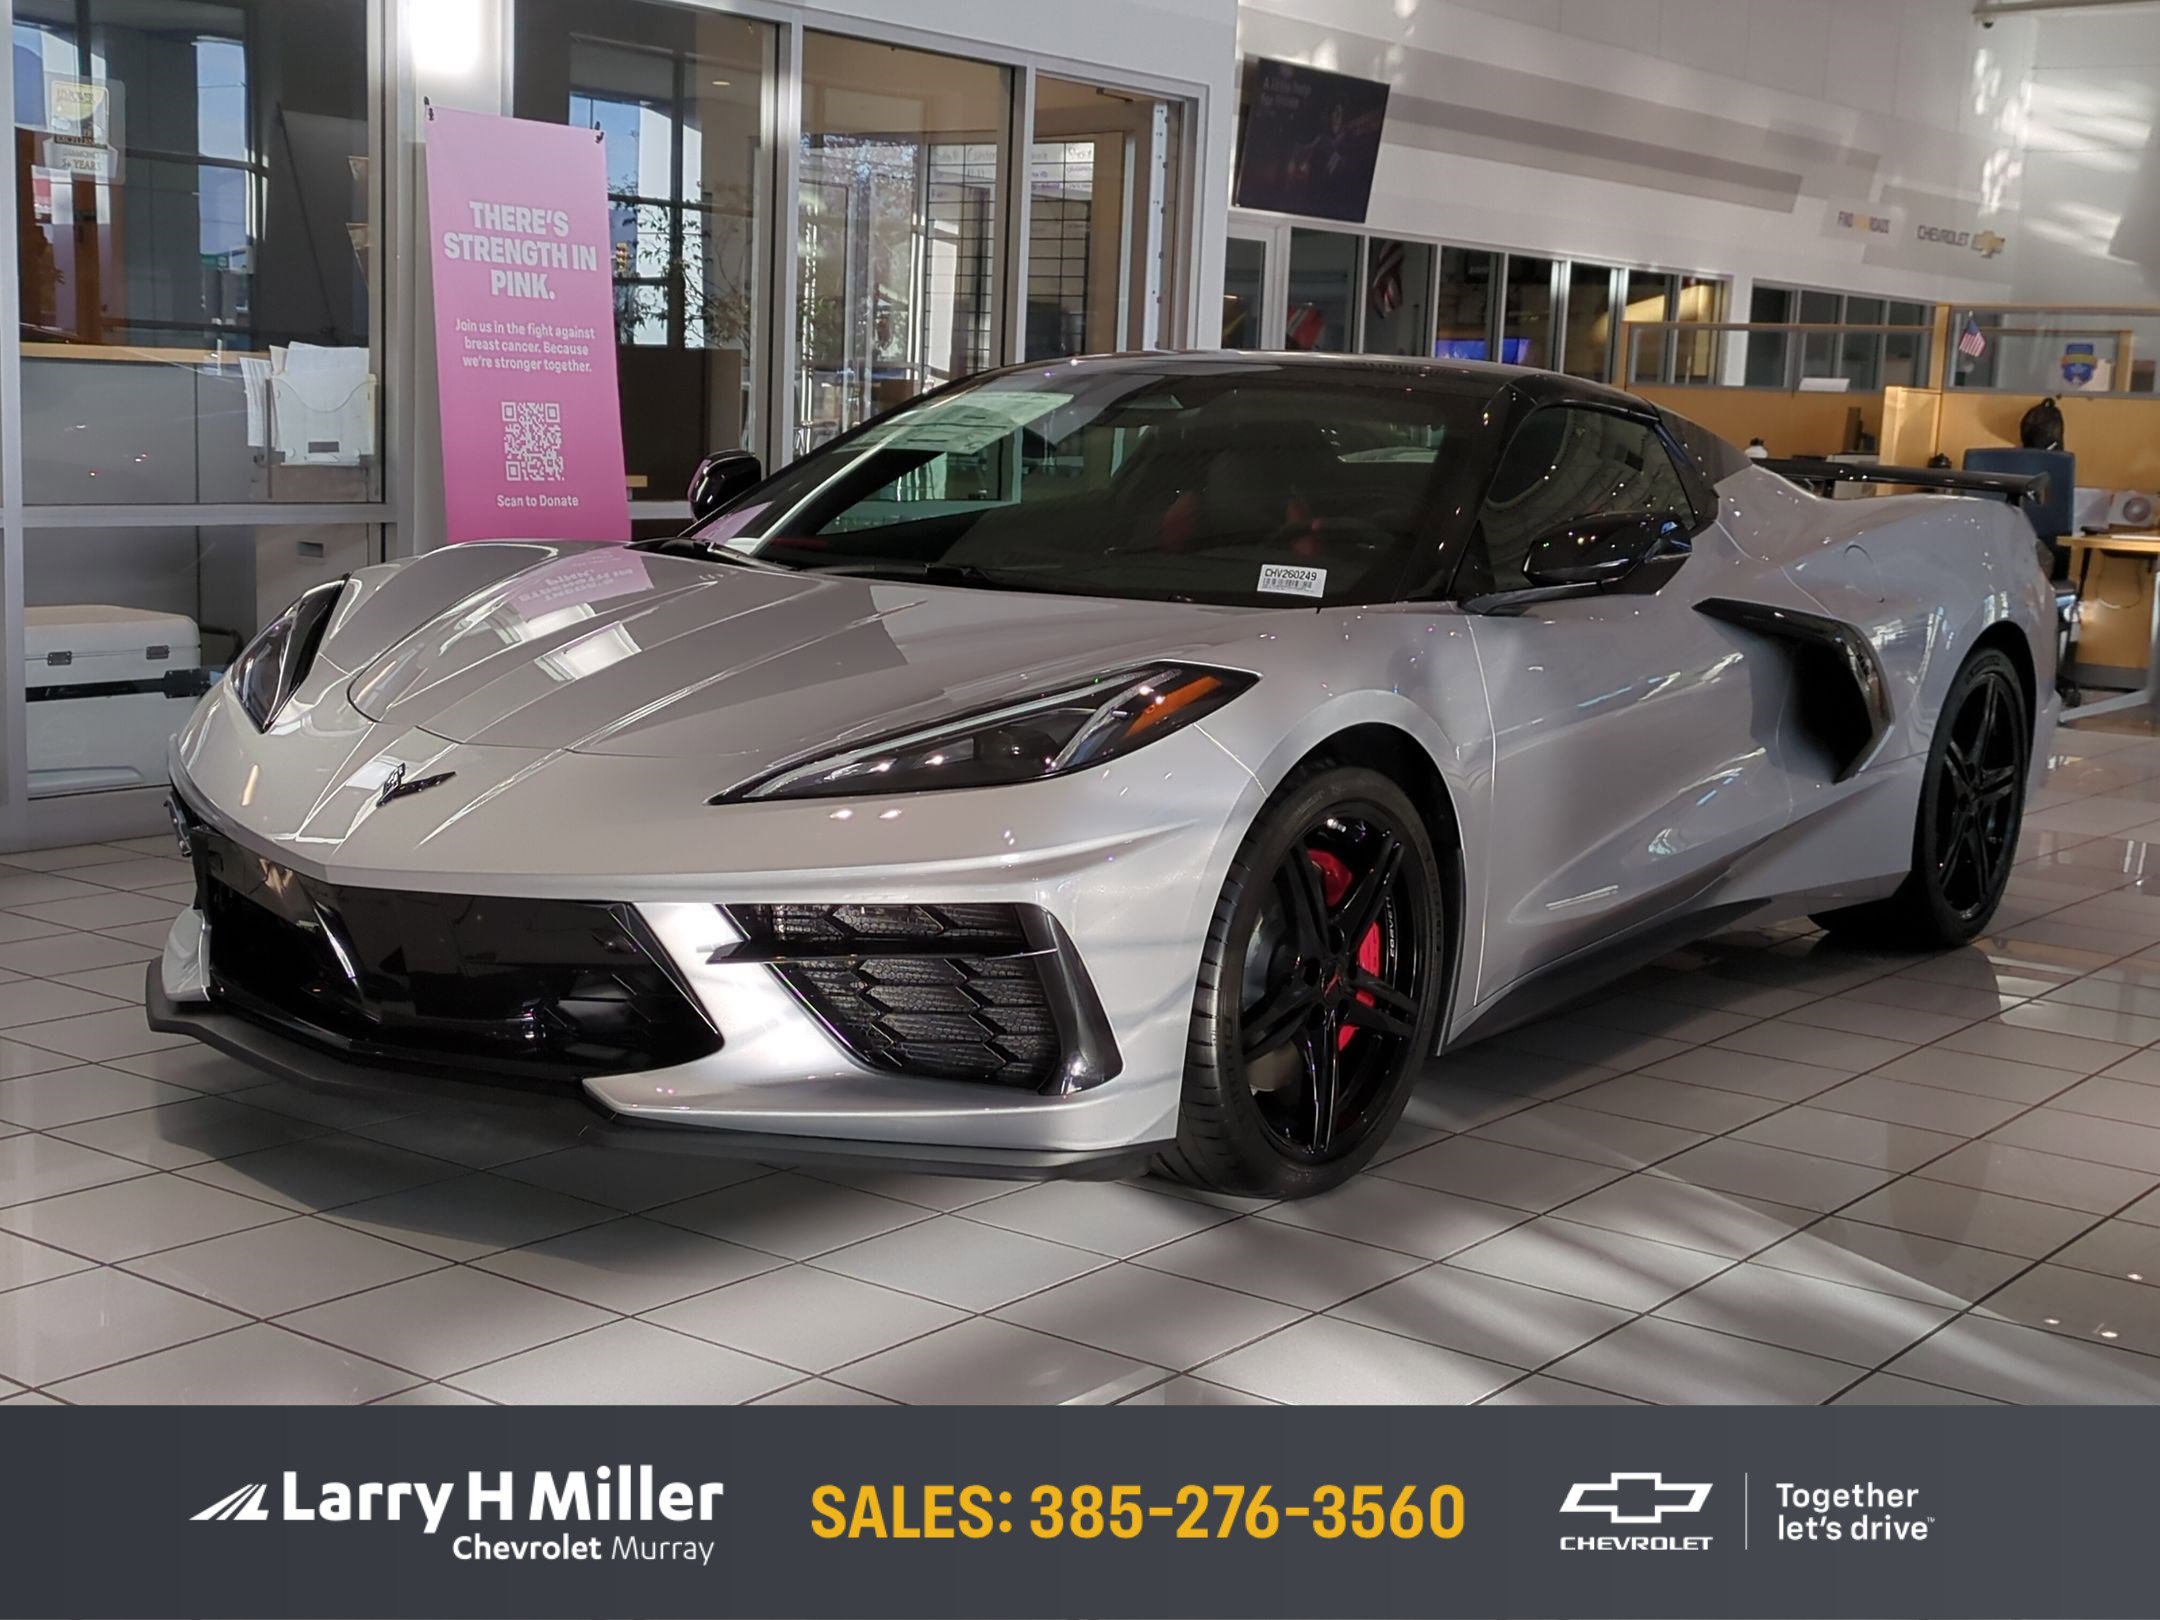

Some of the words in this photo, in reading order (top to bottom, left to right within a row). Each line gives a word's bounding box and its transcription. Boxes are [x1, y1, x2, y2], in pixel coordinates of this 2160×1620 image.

[469, 200, 569, 237] THERE'S
[444, 231, 568, 270] STRENGTH
[572, 244, 597, 272] IN
[490, 269, 556, 300] PINK.
[456, 318, 477, 332] Join
[480, 322, 492, 332] us
[494, 320, 505, 333] in
[506, 321, 525, 336] the
[527, 322, 553, 338] fight
[555, 326, 595, 340] against
[464, 336, 500, 350] breast
[502, 340, 542, 352] cancer.
[544, 341, 589, 354] Because
[462, 355, 493, 368] we're
[494, 357, 542, 372] stronger
[544, 360, 592, 373] together.
[497, 494, 524, 507] Scan
[526, 495, 538, 507] to
[539, 494, 579, 507] Donate
[1265, 568, 1317, 581] CHV260249
